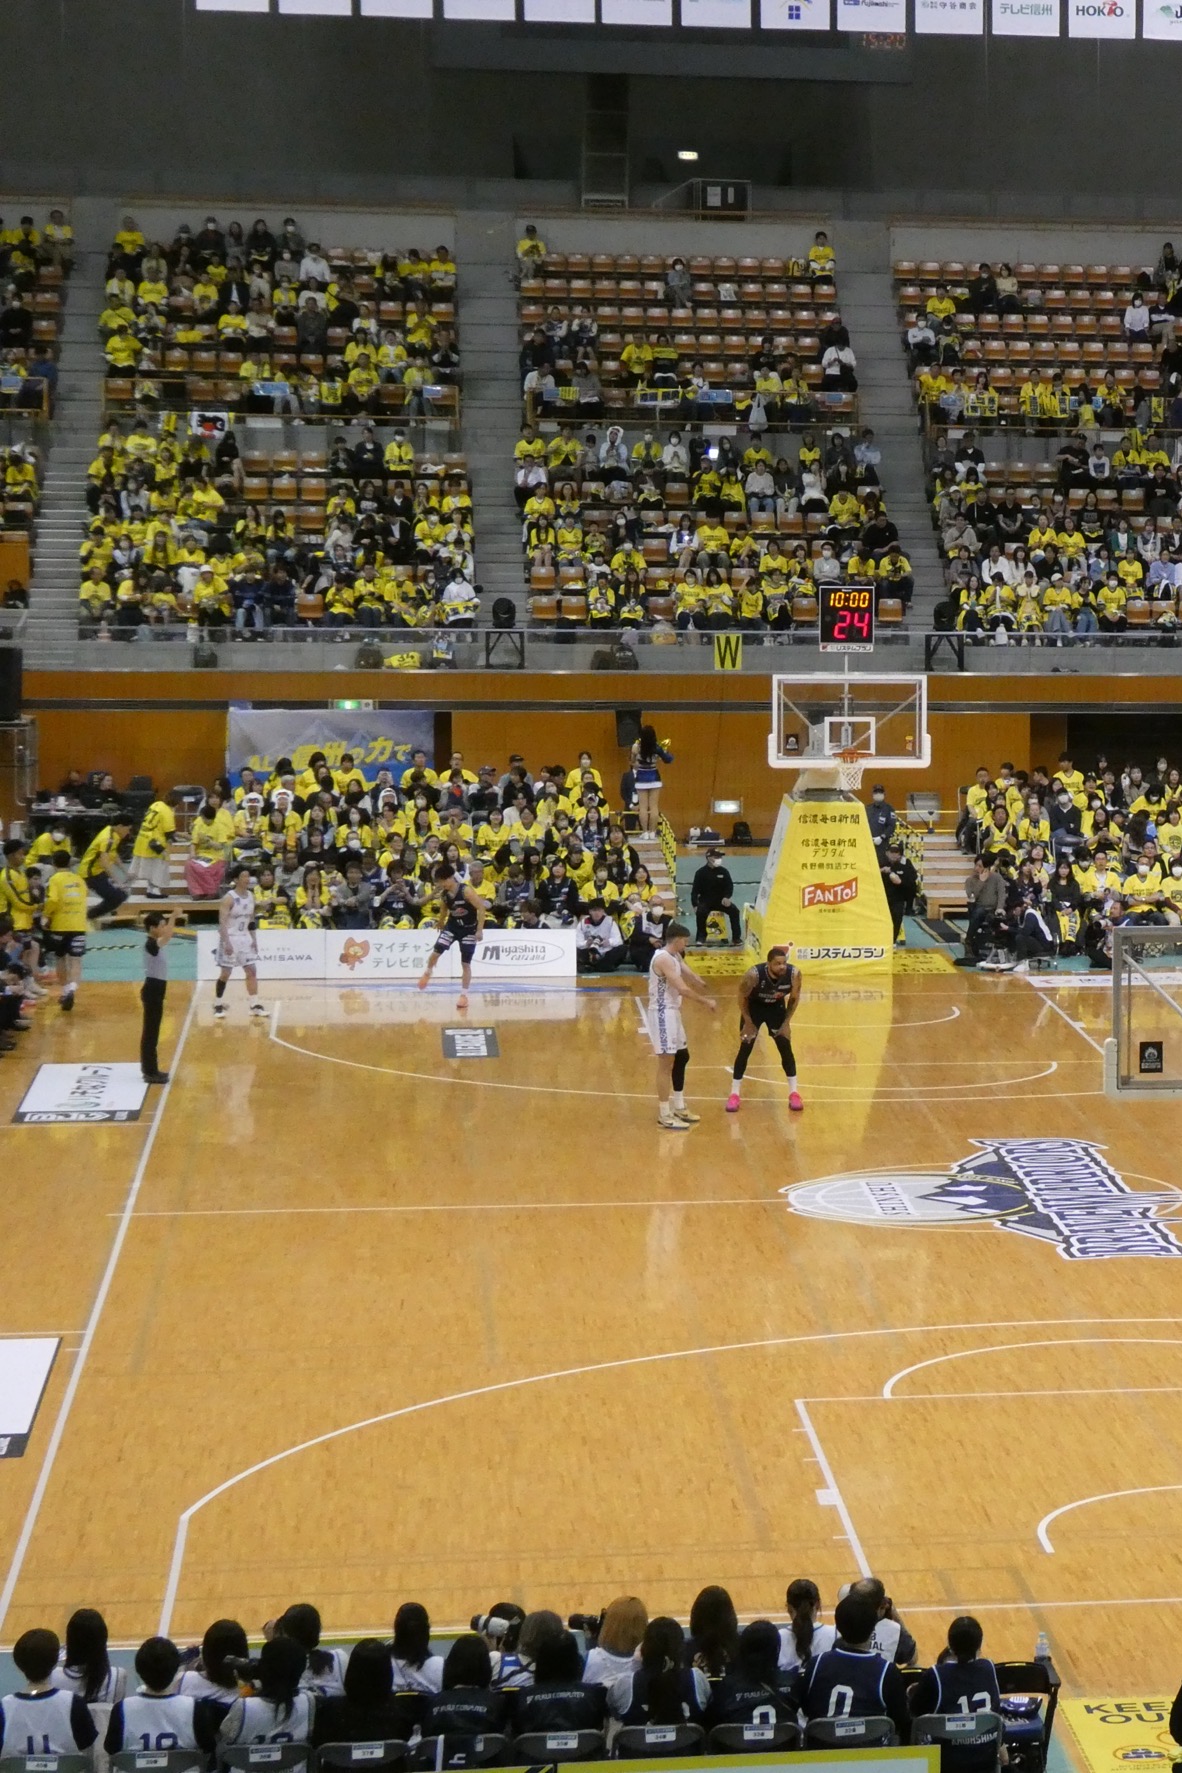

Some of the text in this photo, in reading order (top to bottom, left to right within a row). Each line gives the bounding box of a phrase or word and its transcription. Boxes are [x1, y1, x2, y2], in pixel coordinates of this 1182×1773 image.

[1000, 4, 1053, 16] テレビ信州
[829, 591, 869, 607] 10:00
[833, 611, 870, 639] 24
[716, 635, 740, 669] W
[798, 814, 860, 825] 信濃毎日新聞
[801, 838, 857, 848] 信濃毎日新聞
[255, 954, 313, 962] AMISAWA
[810, 947, 884, 960] システムプラン
[372, 957, 436, 969] テレビ信
[862, 1181, 911, 1215] SHINSHU
[1084, 1700, 1172, 1714] KEE
[1100, 1712, 1172, 1724] OU
